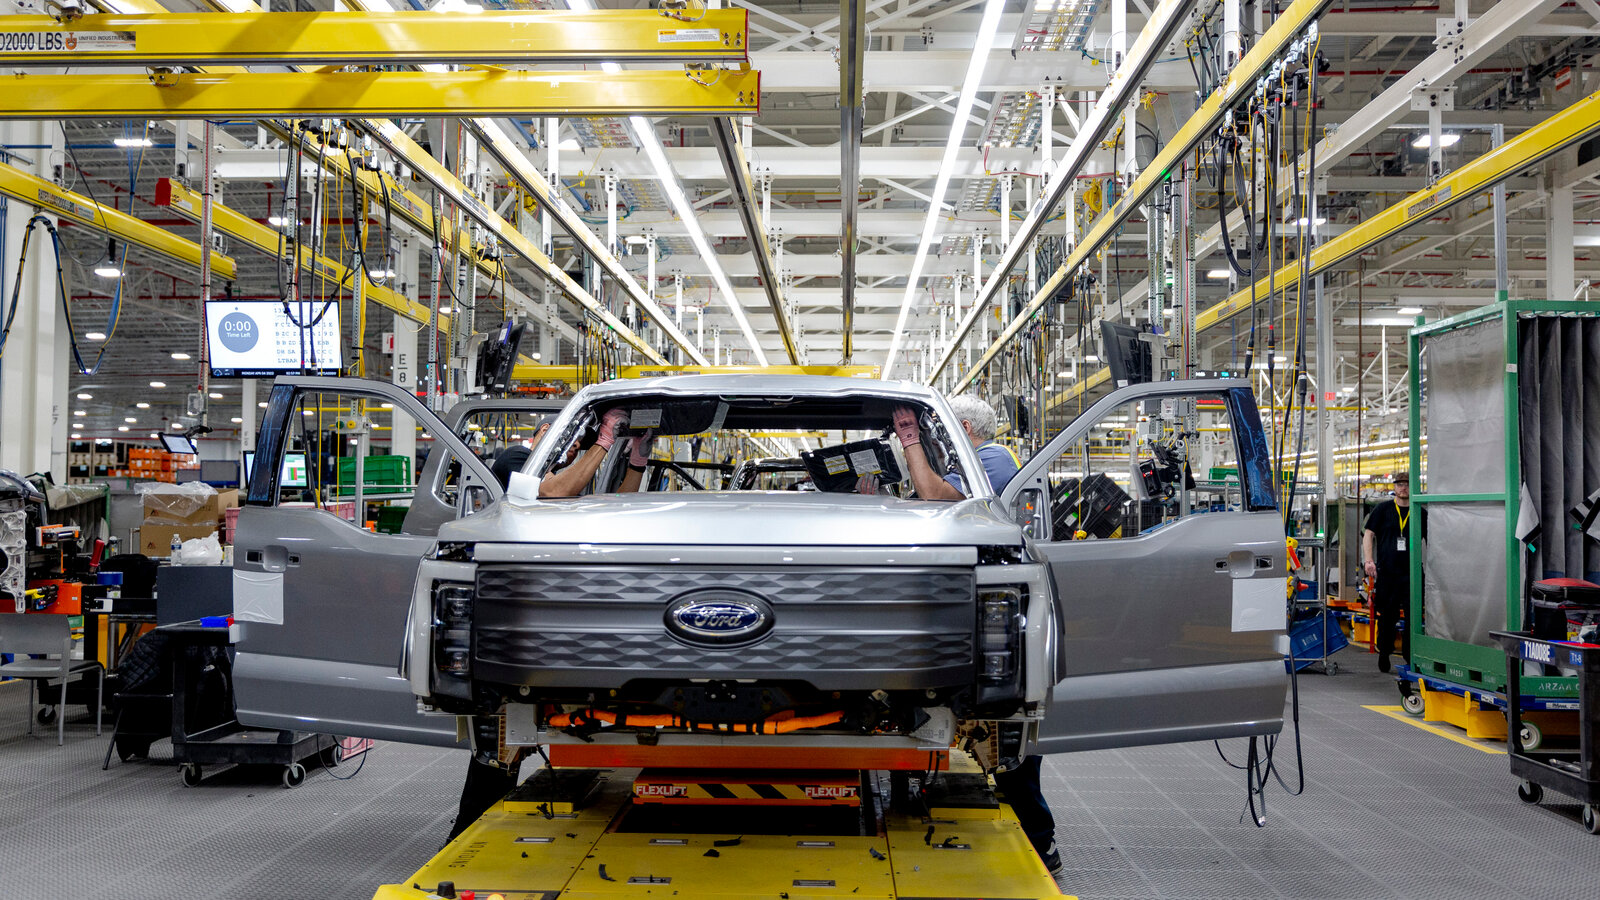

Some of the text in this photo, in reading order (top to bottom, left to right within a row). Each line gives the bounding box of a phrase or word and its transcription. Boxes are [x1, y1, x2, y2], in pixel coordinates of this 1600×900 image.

[38, 32, 65, 50] LBS.
[224, 321, 251, 331] 0:00
[399, 353, 407, 365] E
[399, 372, 406, 383] 8
[694, 607, 742, 627] Ford
[635, 785, 687, 796] FLEXLIFT
[804, 786, 857, 797] FLEXLIFT
